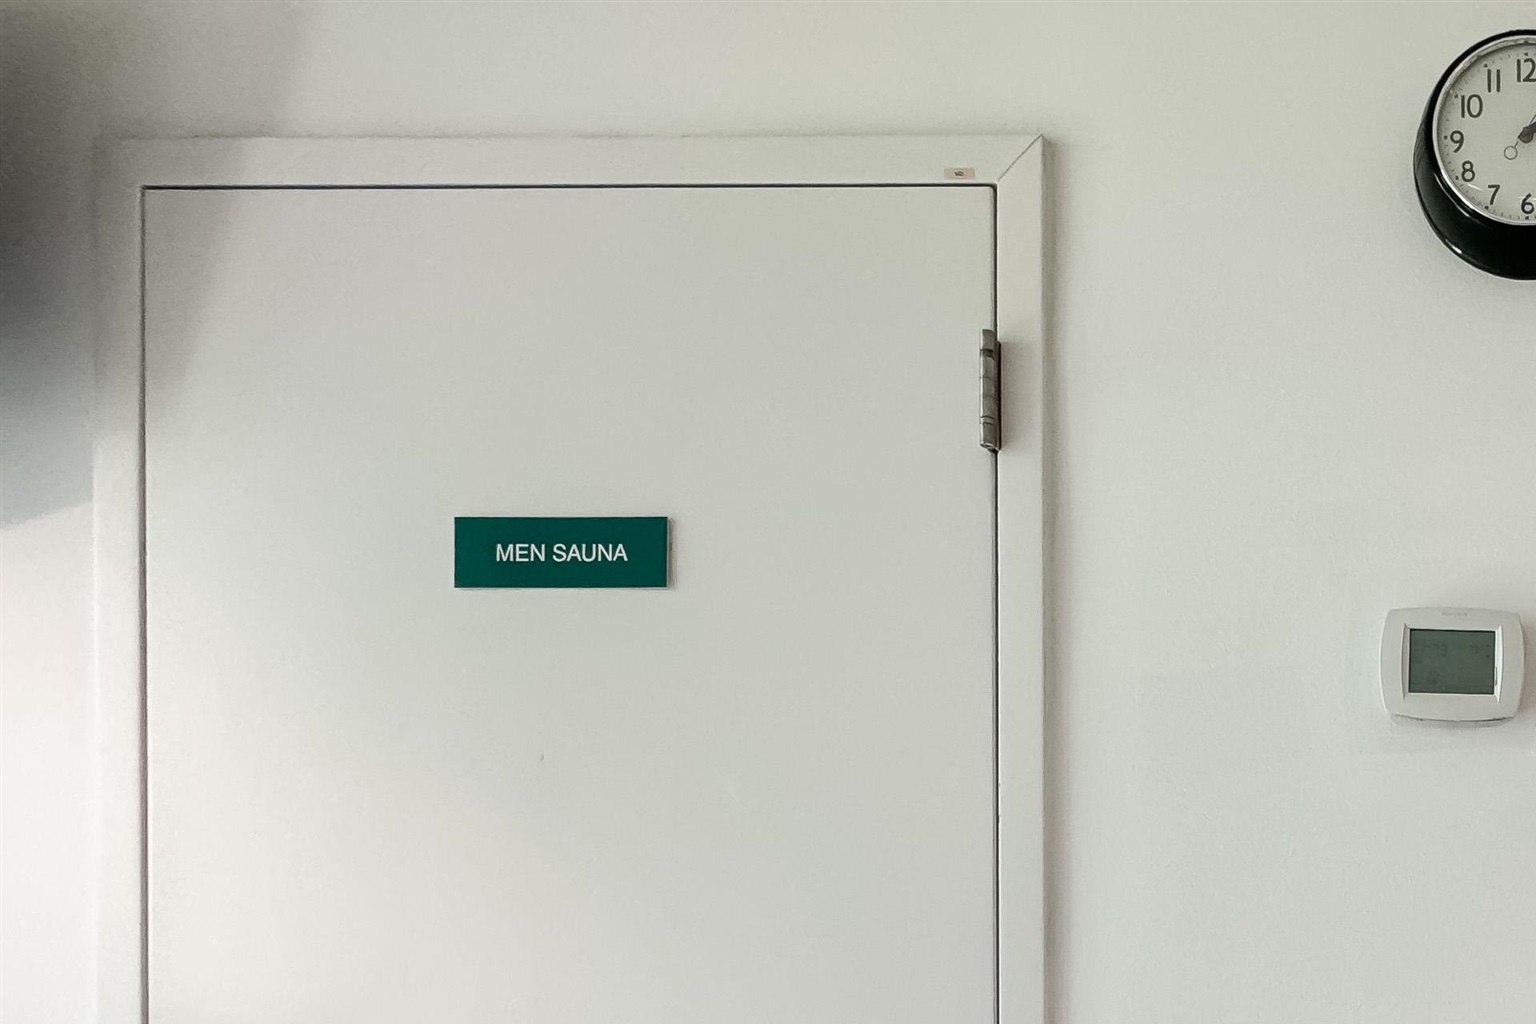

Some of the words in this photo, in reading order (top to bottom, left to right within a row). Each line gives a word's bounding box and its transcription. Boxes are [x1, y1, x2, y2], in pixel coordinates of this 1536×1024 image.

[1486, 68, 1501, 93] 11
[1516, 58, 1536, 82] 12
[1461, 94, 1483, 118] 10
[1450, 130, 1464, 153] 9
[1461, 160, 1476, 182] 8
[1487, 184, 1501, 206] 7
[1520, 193, 1535, 214] 6
[495, 543, 546, 562] MEN
[552, 543, 628, 562] SAUNA
